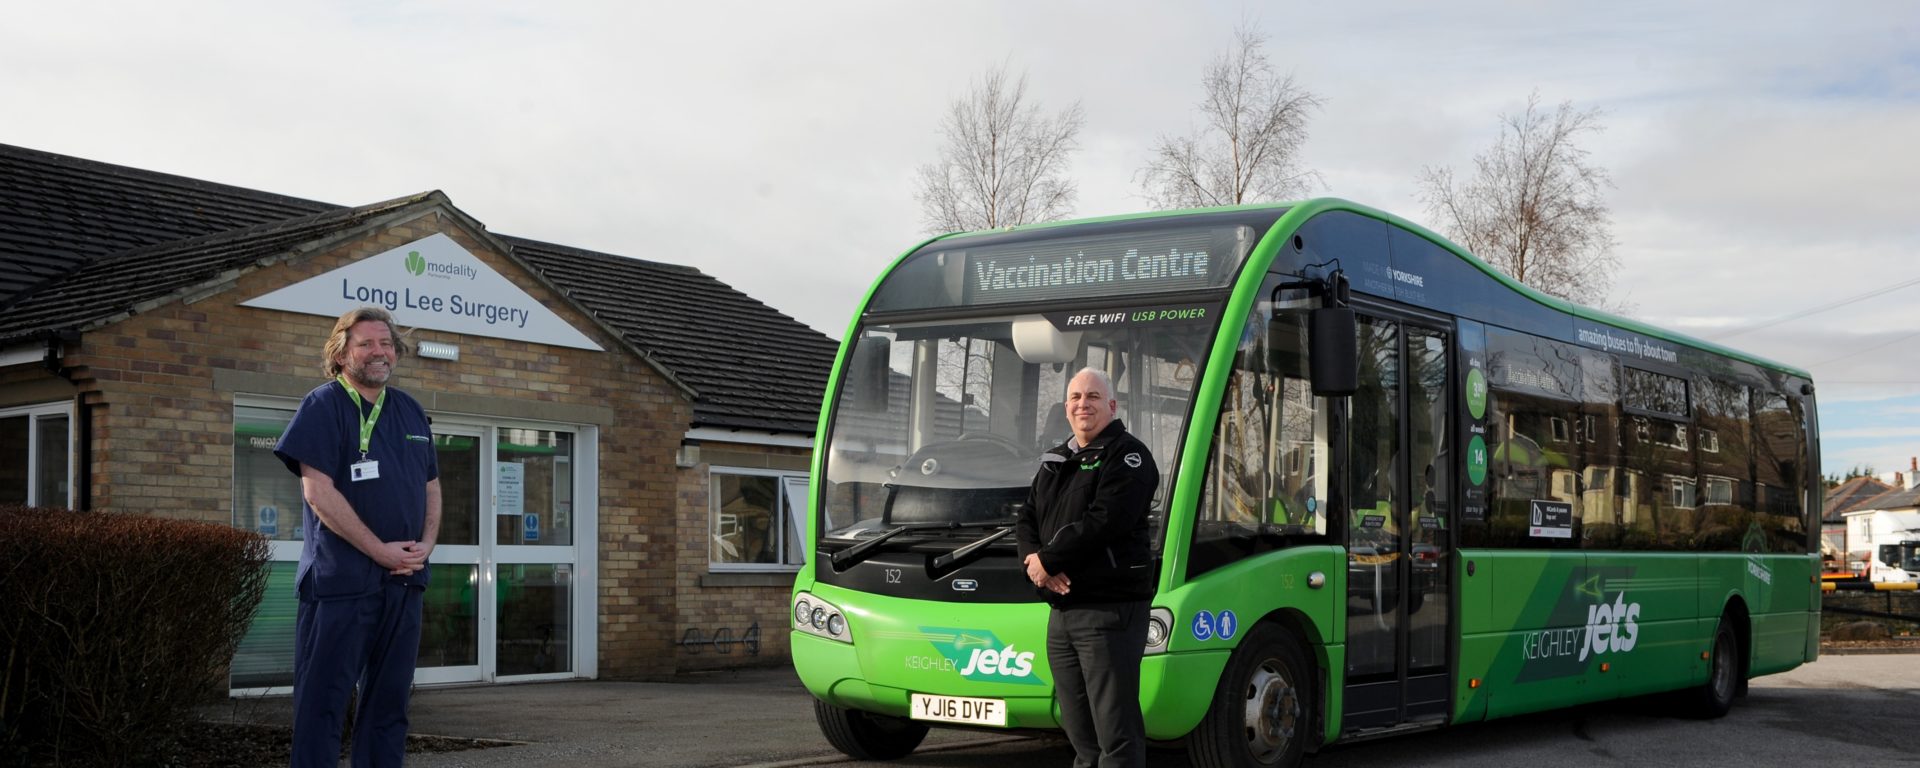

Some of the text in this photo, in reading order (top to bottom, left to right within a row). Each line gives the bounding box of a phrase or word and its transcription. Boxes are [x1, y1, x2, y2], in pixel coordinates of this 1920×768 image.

[427, 261, 477, 280] modality
[976, 249, 1208, 290] Vaccination Centre
[1392, 269, 1424, 287] YORKSHIRE
[343, 279, 529, 328] Long Lee Surgery
[1067, 308, 1206, 326] FREE WIFI USB POWER
[1578, 328, 1678, 363] amazing buses to fly about town
[1474, 449, 1484, 464] 14
[885, 569, 901, 583] 152
[1523, 629, 1580, 660] KEIGHLEY
[905, 656, 958, 671] KEIGHLEY
[922, 698, 994, 720] YJ16 DVF
